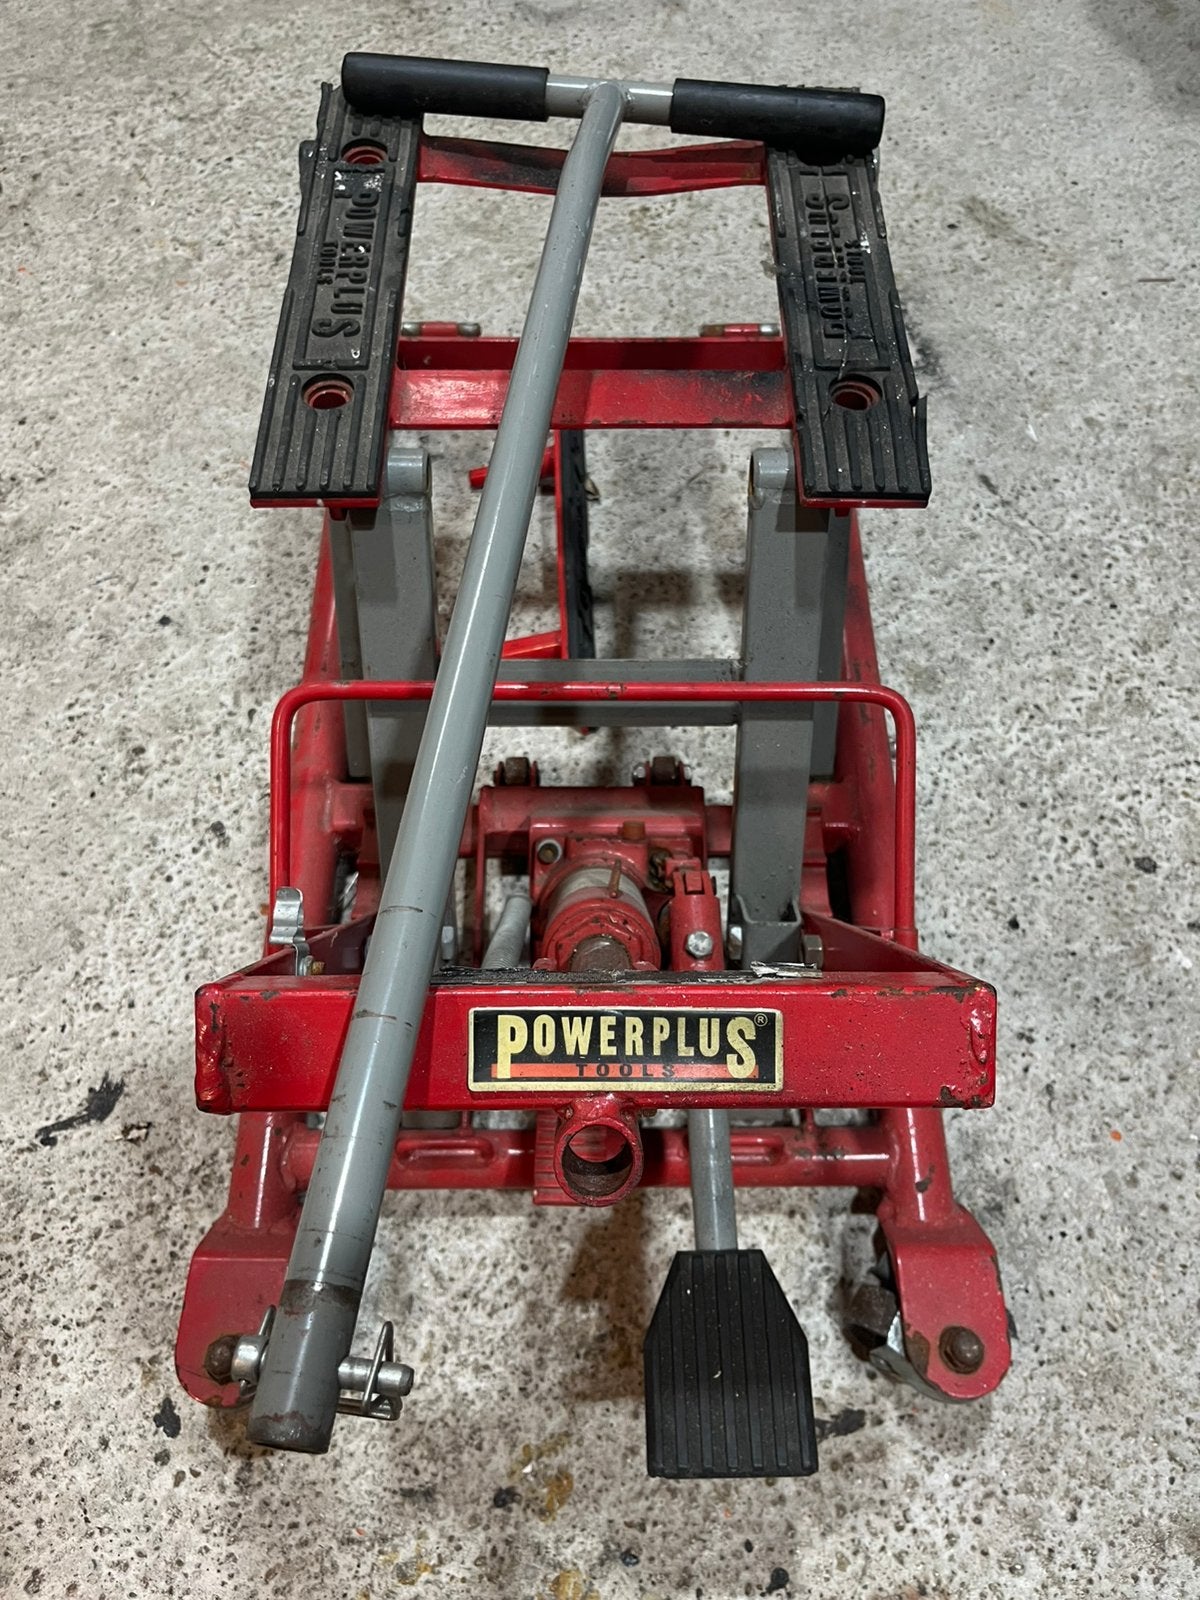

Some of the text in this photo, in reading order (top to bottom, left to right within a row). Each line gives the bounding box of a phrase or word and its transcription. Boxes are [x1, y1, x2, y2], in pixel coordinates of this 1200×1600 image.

[311, 189, 380, 338] POWERPLUS
[316, 241, 339, 285] TOOLS
[805, 193, 874, 339] POWERPLUS
[497, 1014, 757, 1079] POWERPLUS
[576, 1063, 676, 1077] TOOLS
